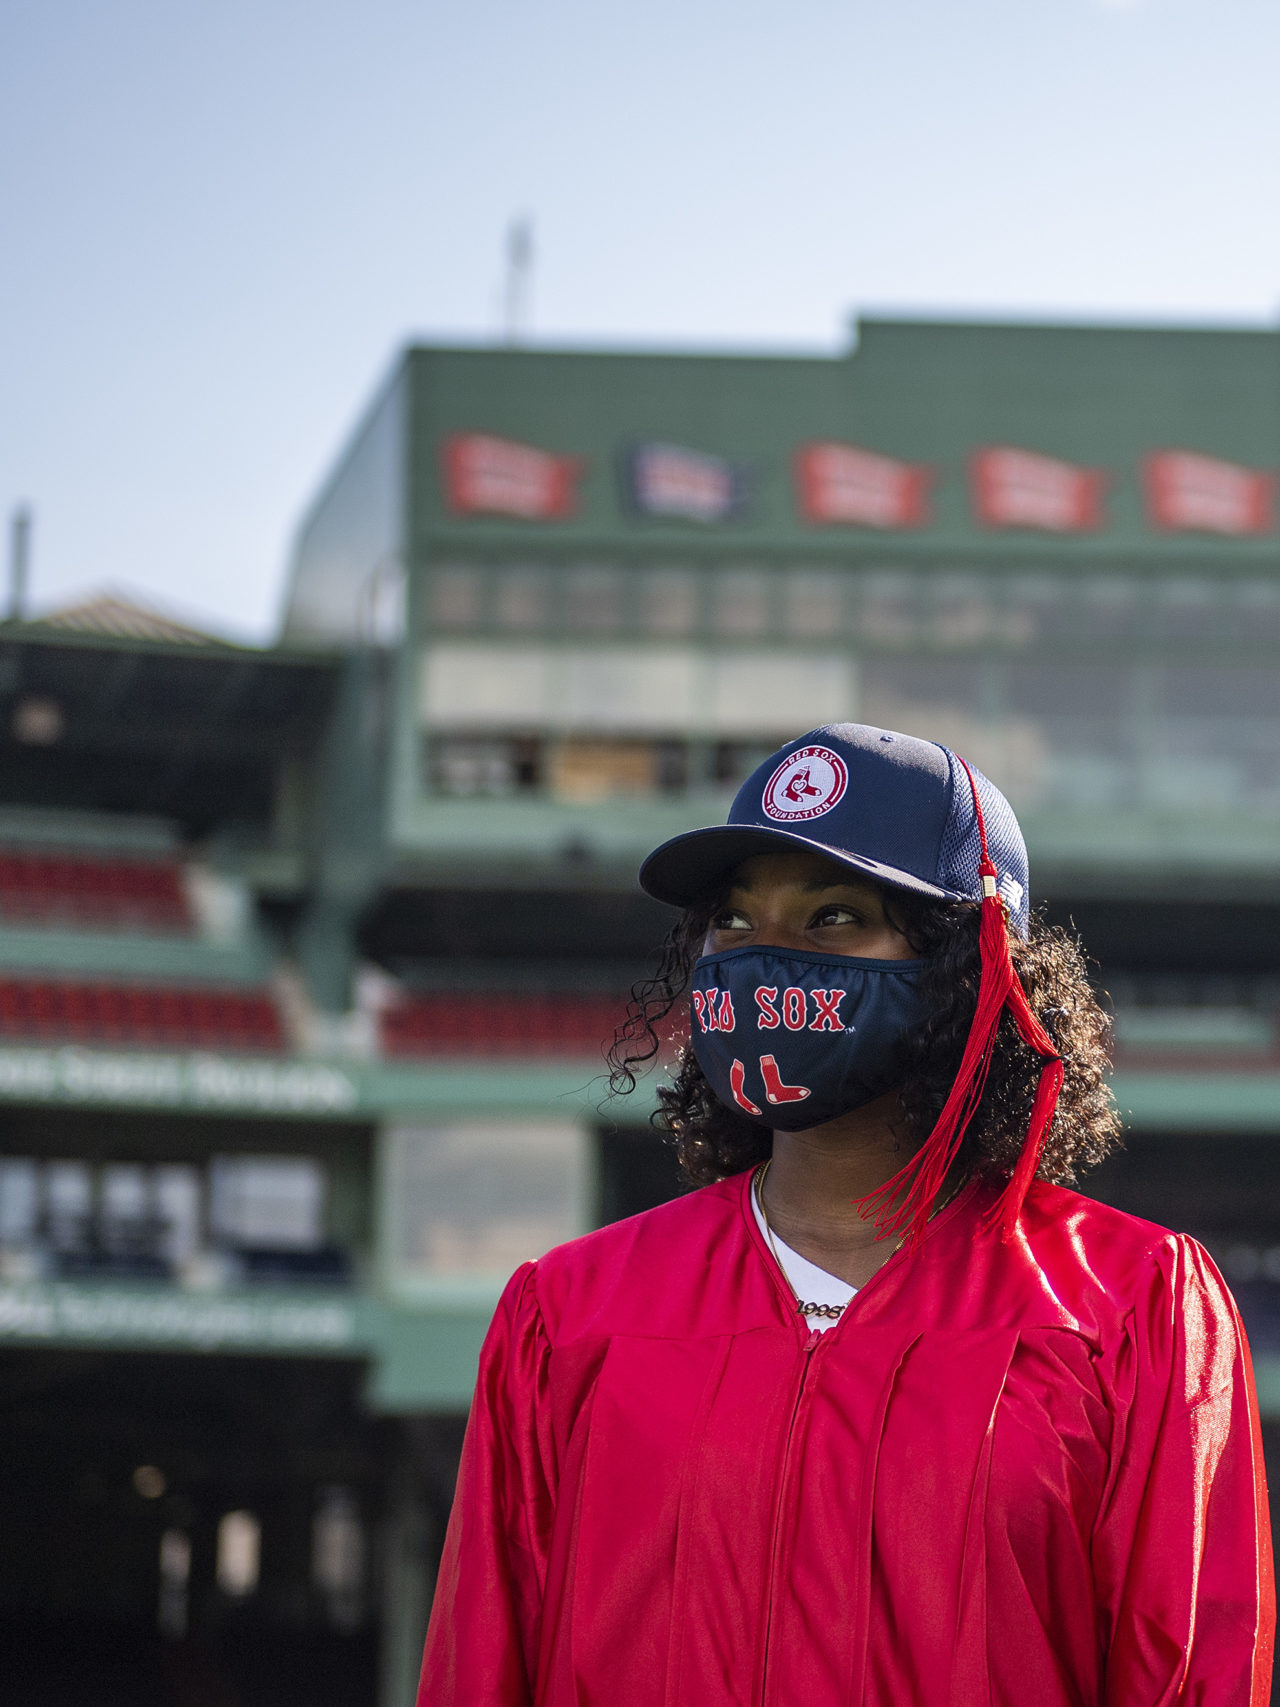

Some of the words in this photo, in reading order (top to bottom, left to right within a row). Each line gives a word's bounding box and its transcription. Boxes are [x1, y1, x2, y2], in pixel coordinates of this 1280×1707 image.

[788, 750, 809, 765] RED
[813, 749, 837, 763] SOX
[766, 801, 831, 819] FOUNDATION
[754, 986, 847, 1032] SOX
[797, 1300, 843, 1319] 1998
